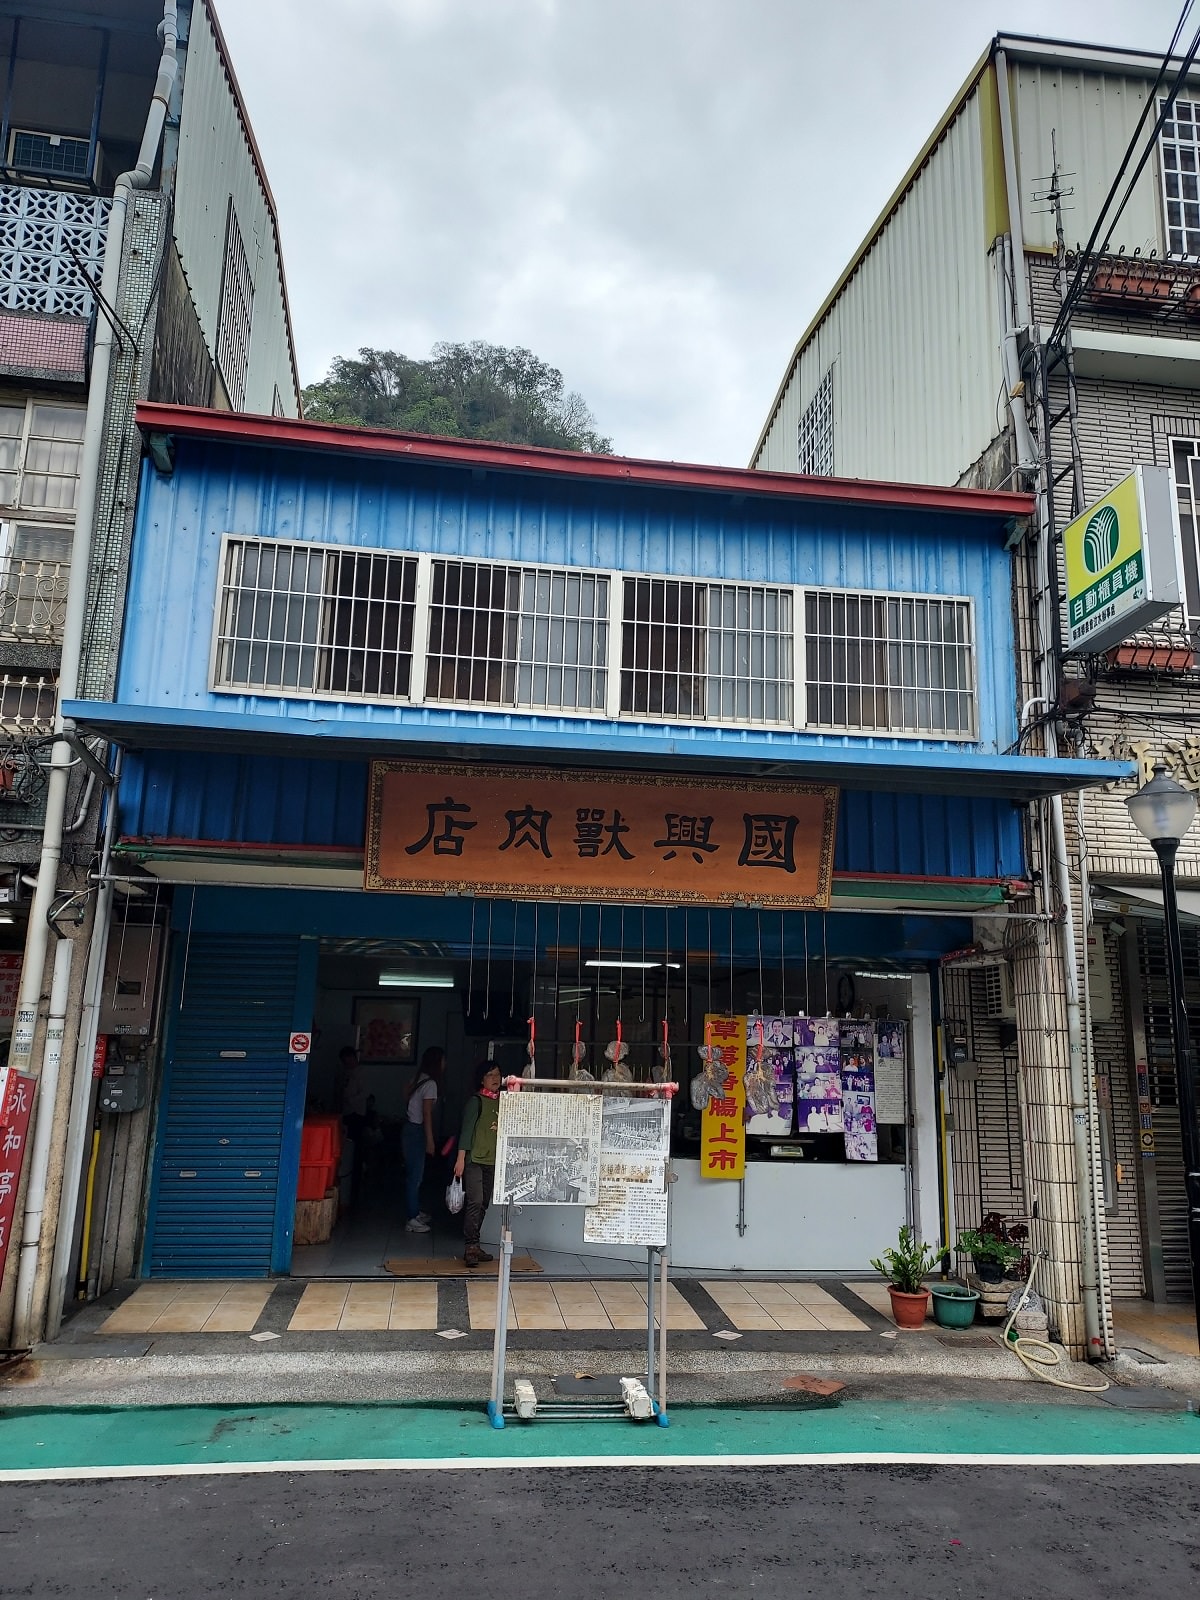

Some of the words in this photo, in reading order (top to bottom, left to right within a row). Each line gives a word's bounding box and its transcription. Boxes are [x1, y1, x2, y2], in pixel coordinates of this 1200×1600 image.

[1073, 560, 1138, 621] 自動櫃員機
[404, 796, 800, 873] 國興獸肉店
